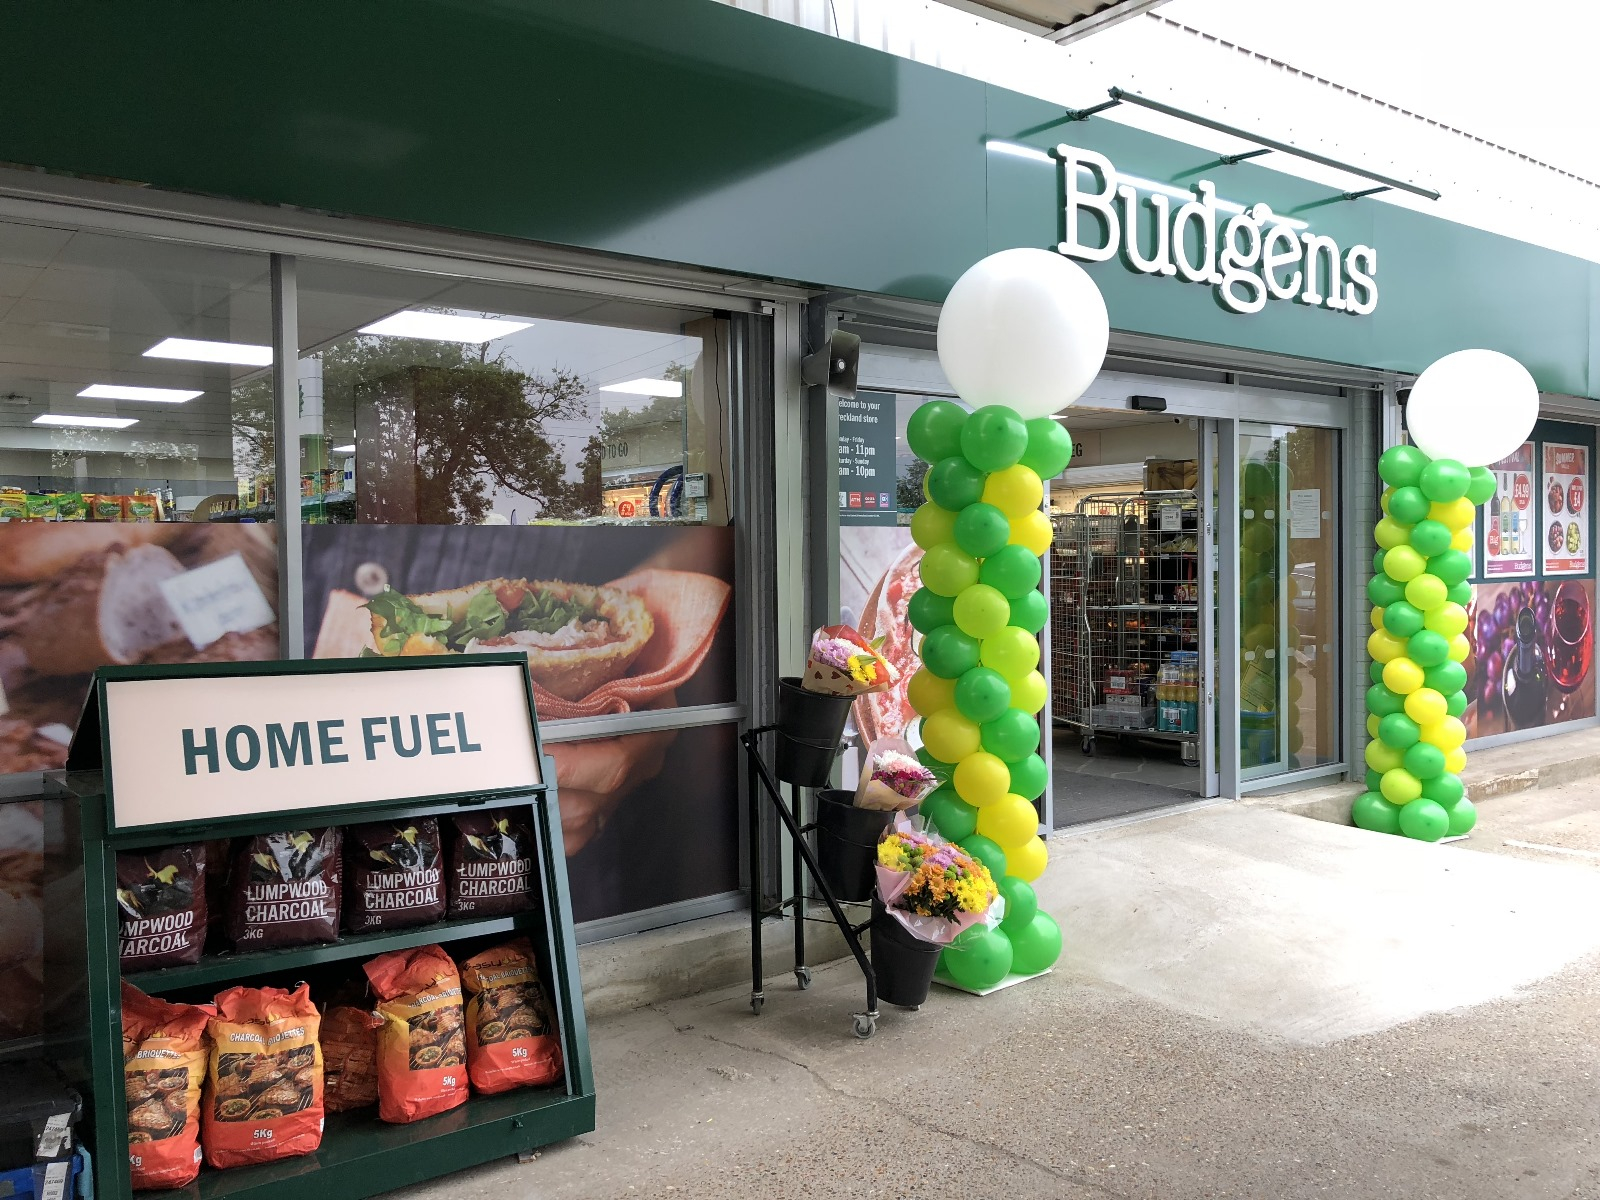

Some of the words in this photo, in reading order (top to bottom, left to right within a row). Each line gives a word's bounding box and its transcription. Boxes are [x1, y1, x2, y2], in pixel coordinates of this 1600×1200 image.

[1056, 143, 1377, 315] Budgens
[839, 399, 859, 408] elcome
[860, 400, 866, 409] to
[867, 402, 880, 411] your
[838, 413, 862, 422] eckland
[863, 415, 878, 423] store
[852, 436, 865, 444] Friday
[608, 444, 616, 459] TO
[618, 442, 628, 457] GO
[839, 446, 849, 454] am
[856, 444, 875, 457] 11pm
[1071, 443, 1083, 457] EG
[855, 457, 869, 465] Sunday
[839, 467, 849, 476] am
[856, 466, 876, 478] 10pm
[1490, 535, 1499, 546] Big
[182, 719, 349, 776] HOME
[361, 711, 482, 760] FUEL
[460, 858, 532, 877] LUMPWOOD
[366, 868, 439, 889] LUMPWOOD
[247, 880, 327, 901] LUMPWOOD
[460, 876, 531, 896] CHARCOAL
[364, 886, 439, 910] CHARCOAL
[245, 900, 328, 922] CHARCOAL
[458, 901, 475, 911] 3KG
[119, 911, 194, 937] MPWOOD
[364, 915, 382, 925] 3KG
[243, 928, 264, 939] 3KG
[119, 931, 190, 956] ARCOAL
[230, 1033, 266, 1045] CHARCOAL
[512, 1047, 528, 1058] 5Kg
[442, 1075, 456, 1087] 5Kg
[253, 1128, 273, 1139] 5Kg
[129, 1154, 142, 1167] Kg
